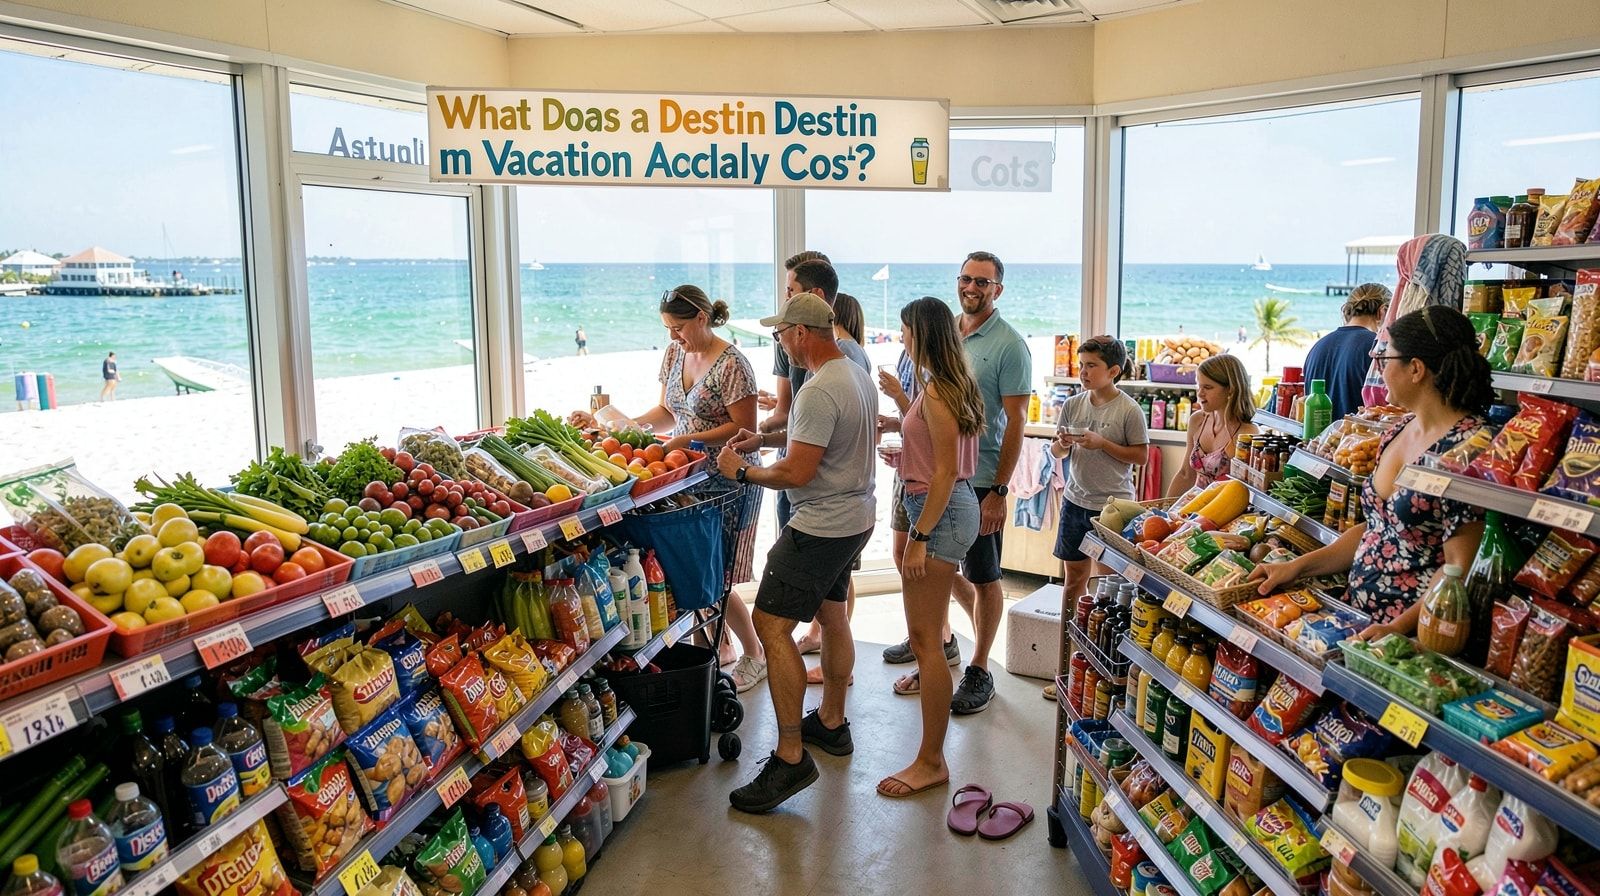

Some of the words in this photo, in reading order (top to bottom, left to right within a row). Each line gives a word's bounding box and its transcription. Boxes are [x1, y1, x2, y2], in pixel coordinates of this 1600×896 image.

[436, 94, 531, 131] What
[542, 97, 621, 133] Doas
[630, 108, 649, 133] a
[659, 98, 766, 135] Destin
[774, 100, 877, 137] Destin
[439, 149, 472, 175] m
[481, 139, 632, 177] Vacation
[644, 141, 770, 185] Acclaly
[970, 155, 1040, 188] Cots
